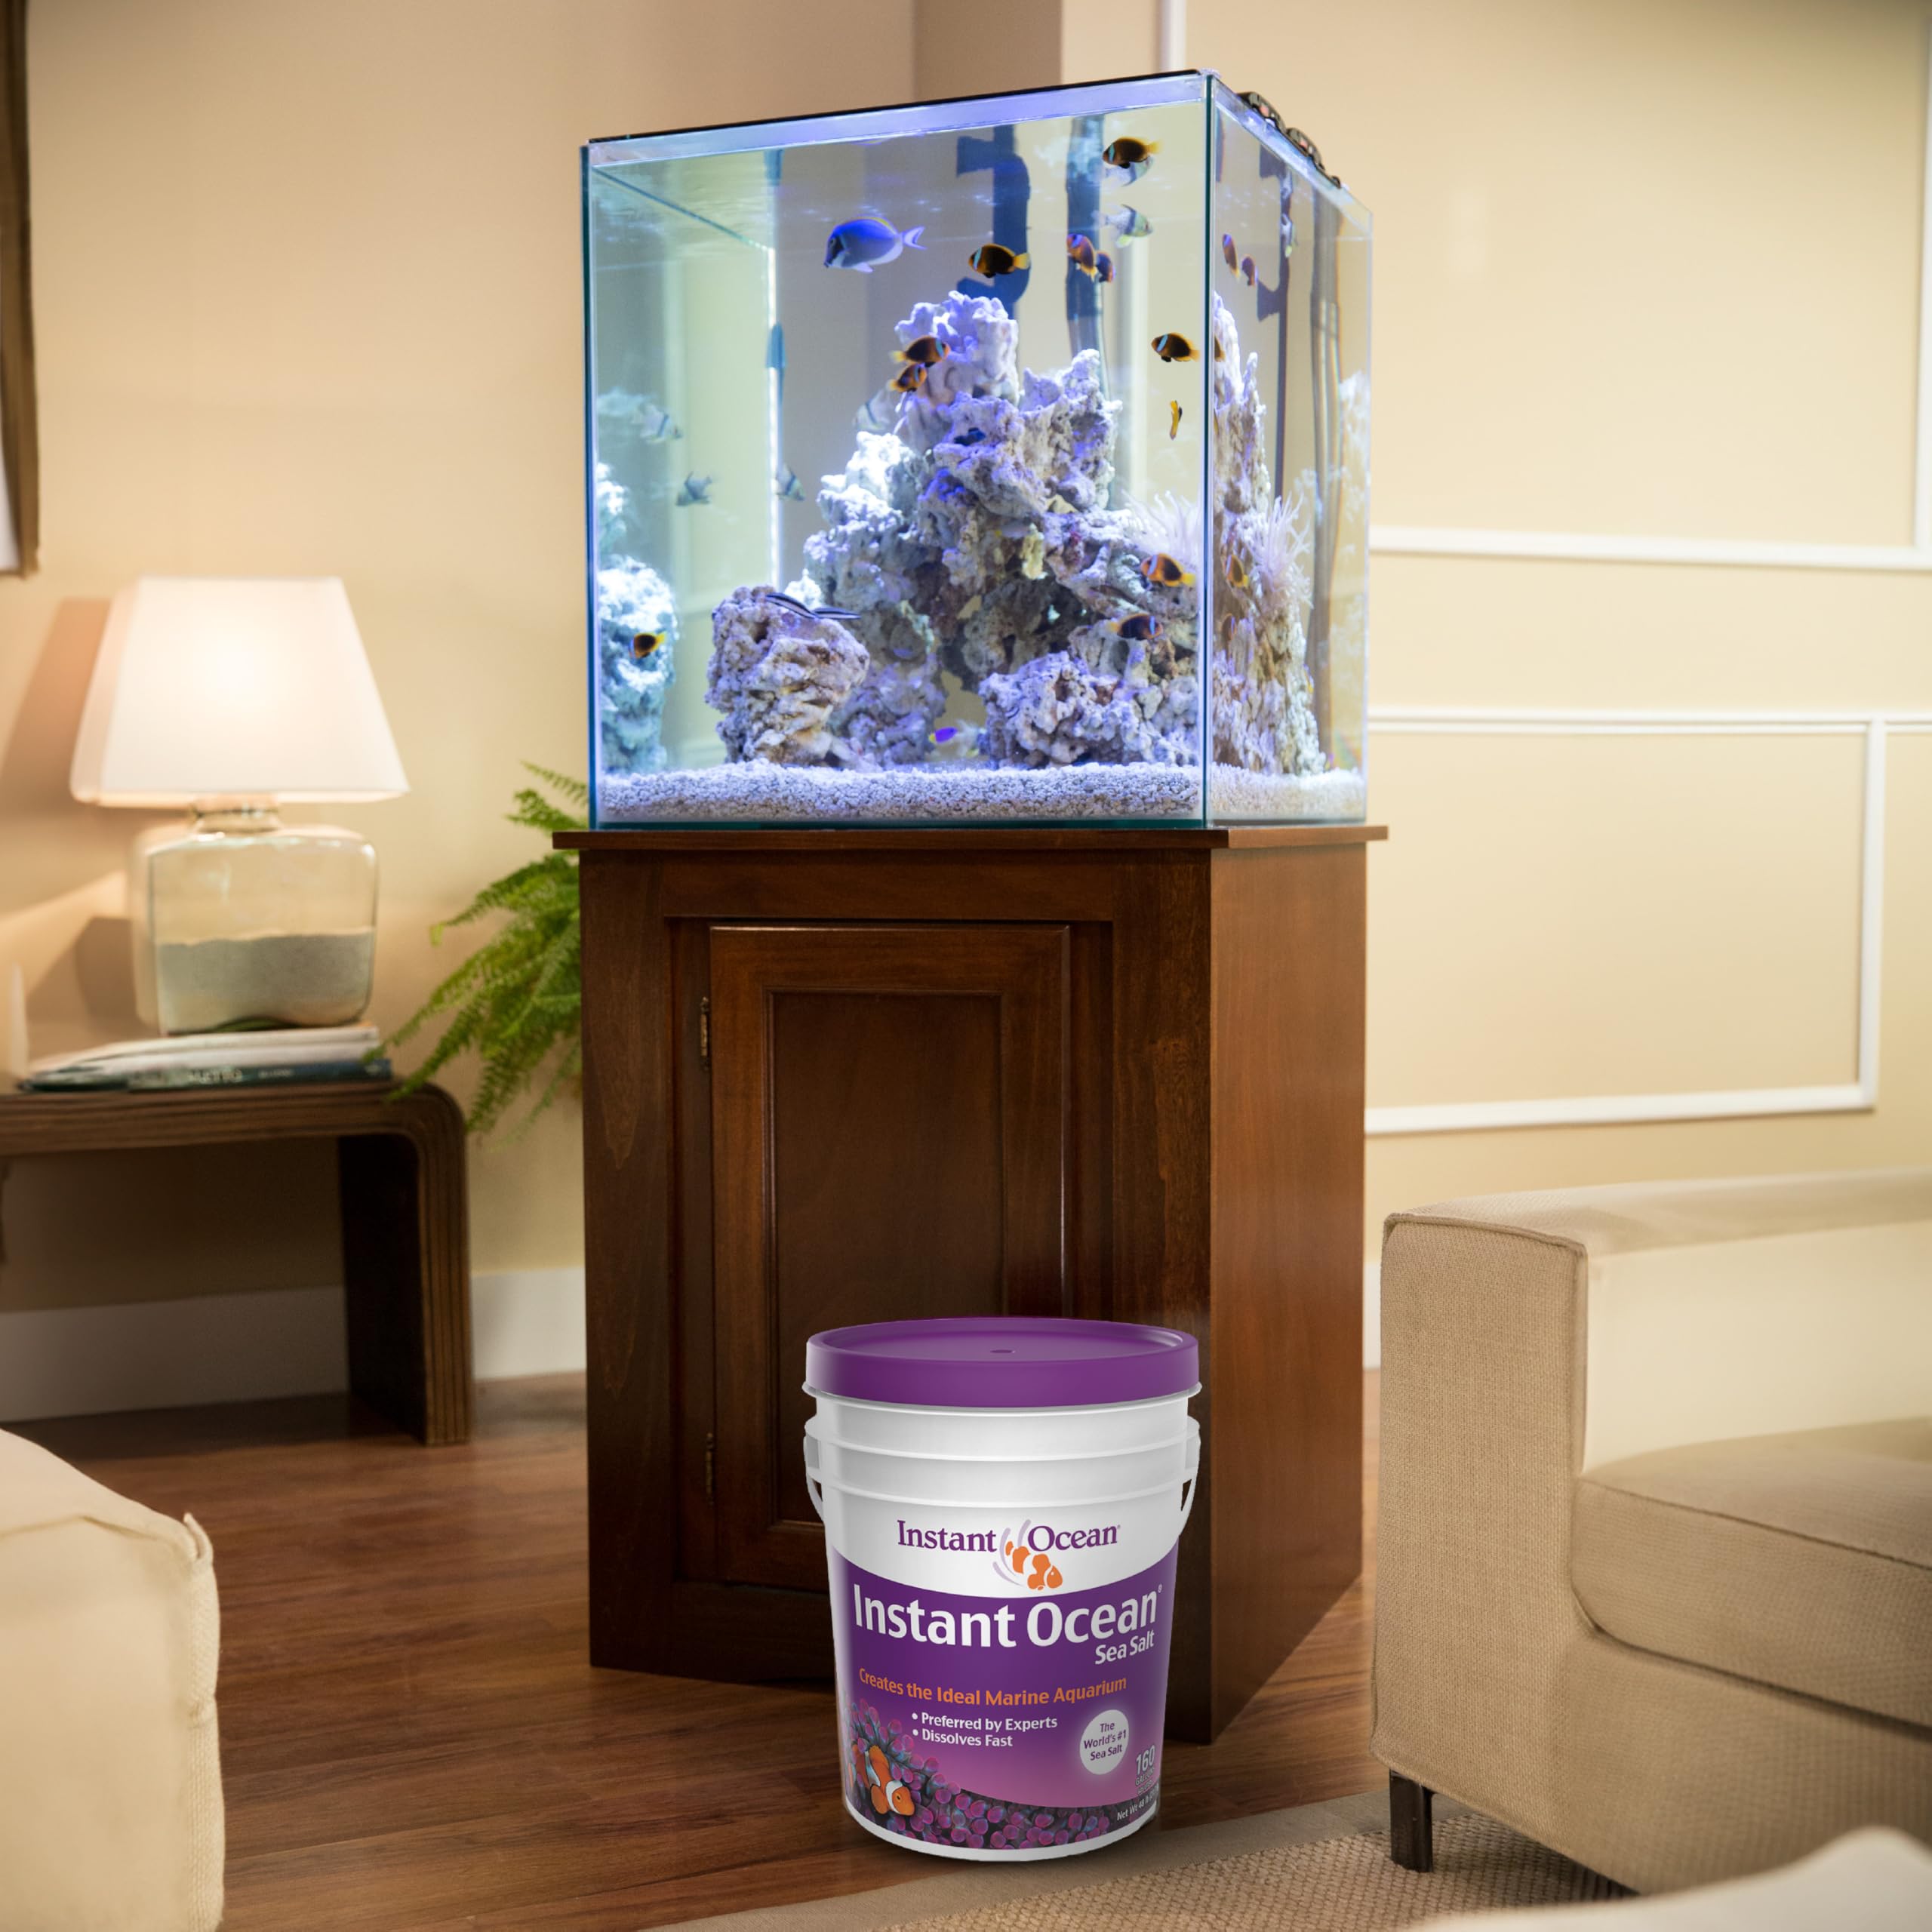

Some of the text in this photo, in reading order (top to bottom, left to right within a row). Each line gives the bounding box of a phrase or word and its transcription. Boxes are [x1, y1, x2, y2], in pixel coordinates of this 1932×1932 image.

[897, 1520, 997, 1552] Instant
[854, 1583, 1017, 1647] Instant
[1095, 1629, 1155, 1665] Sea Salt
[860, 1668, 1127, 1706] Creates the Ideal Marine Aquarium
[921, 1712, 1057, 1733] Preferred by Experts
[1100, 1722, 1115, 1734] The
[922, 1728, 1013, 1747] Dissolves Fast
[1084, 1730, 1127, 1749] World's #1
[1090, 1744, 1123, 1761] Sea Salt
[1136, 1745, 1155, 1776] 160
[1117, 1810, 1128, 1821] Net
